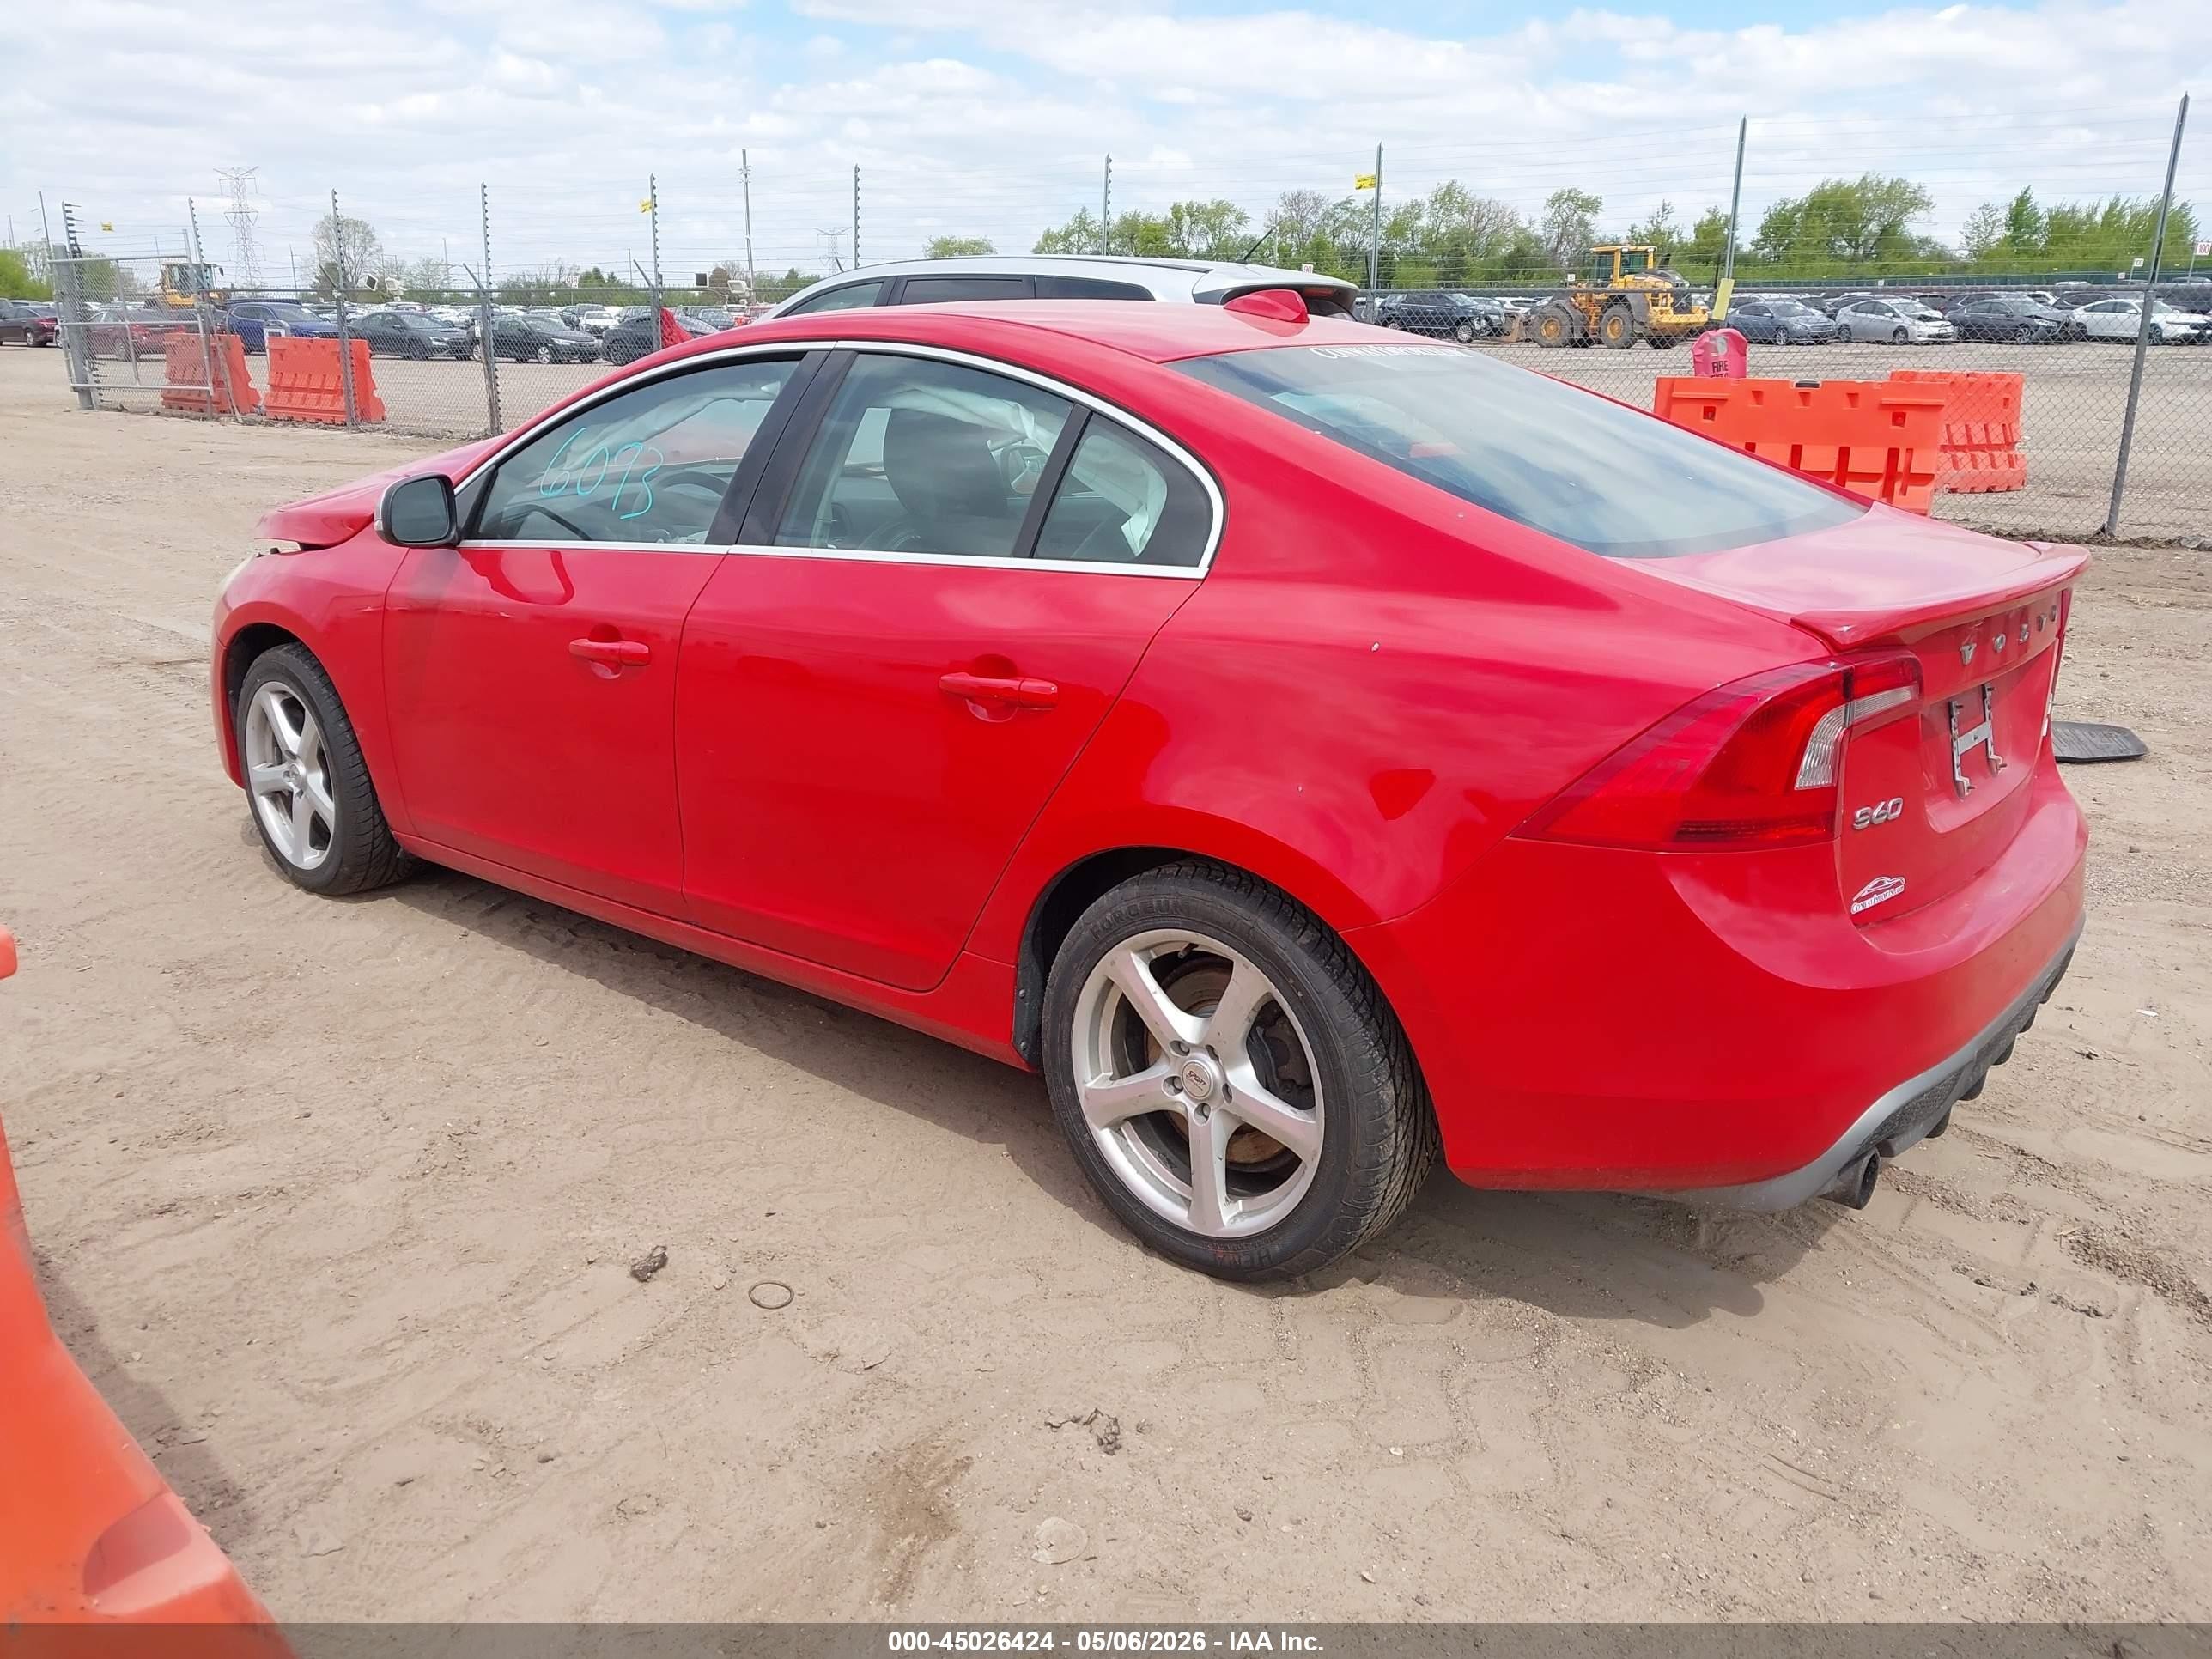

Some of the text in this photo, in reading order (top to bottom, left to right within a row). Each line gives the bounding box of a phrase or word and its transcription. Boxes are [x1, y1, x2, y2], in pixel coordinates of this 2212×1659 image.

[2198, 244, 2210, 254] 100
[1711, 361, 1729, 374] FIRE
[539, 427, 664, 520] 6093
[1960, 605, 2057, 665] VOLVO
[1853, 797, 1904, 830] S60
[1187, 1070, 1207, 1086] SPORT
